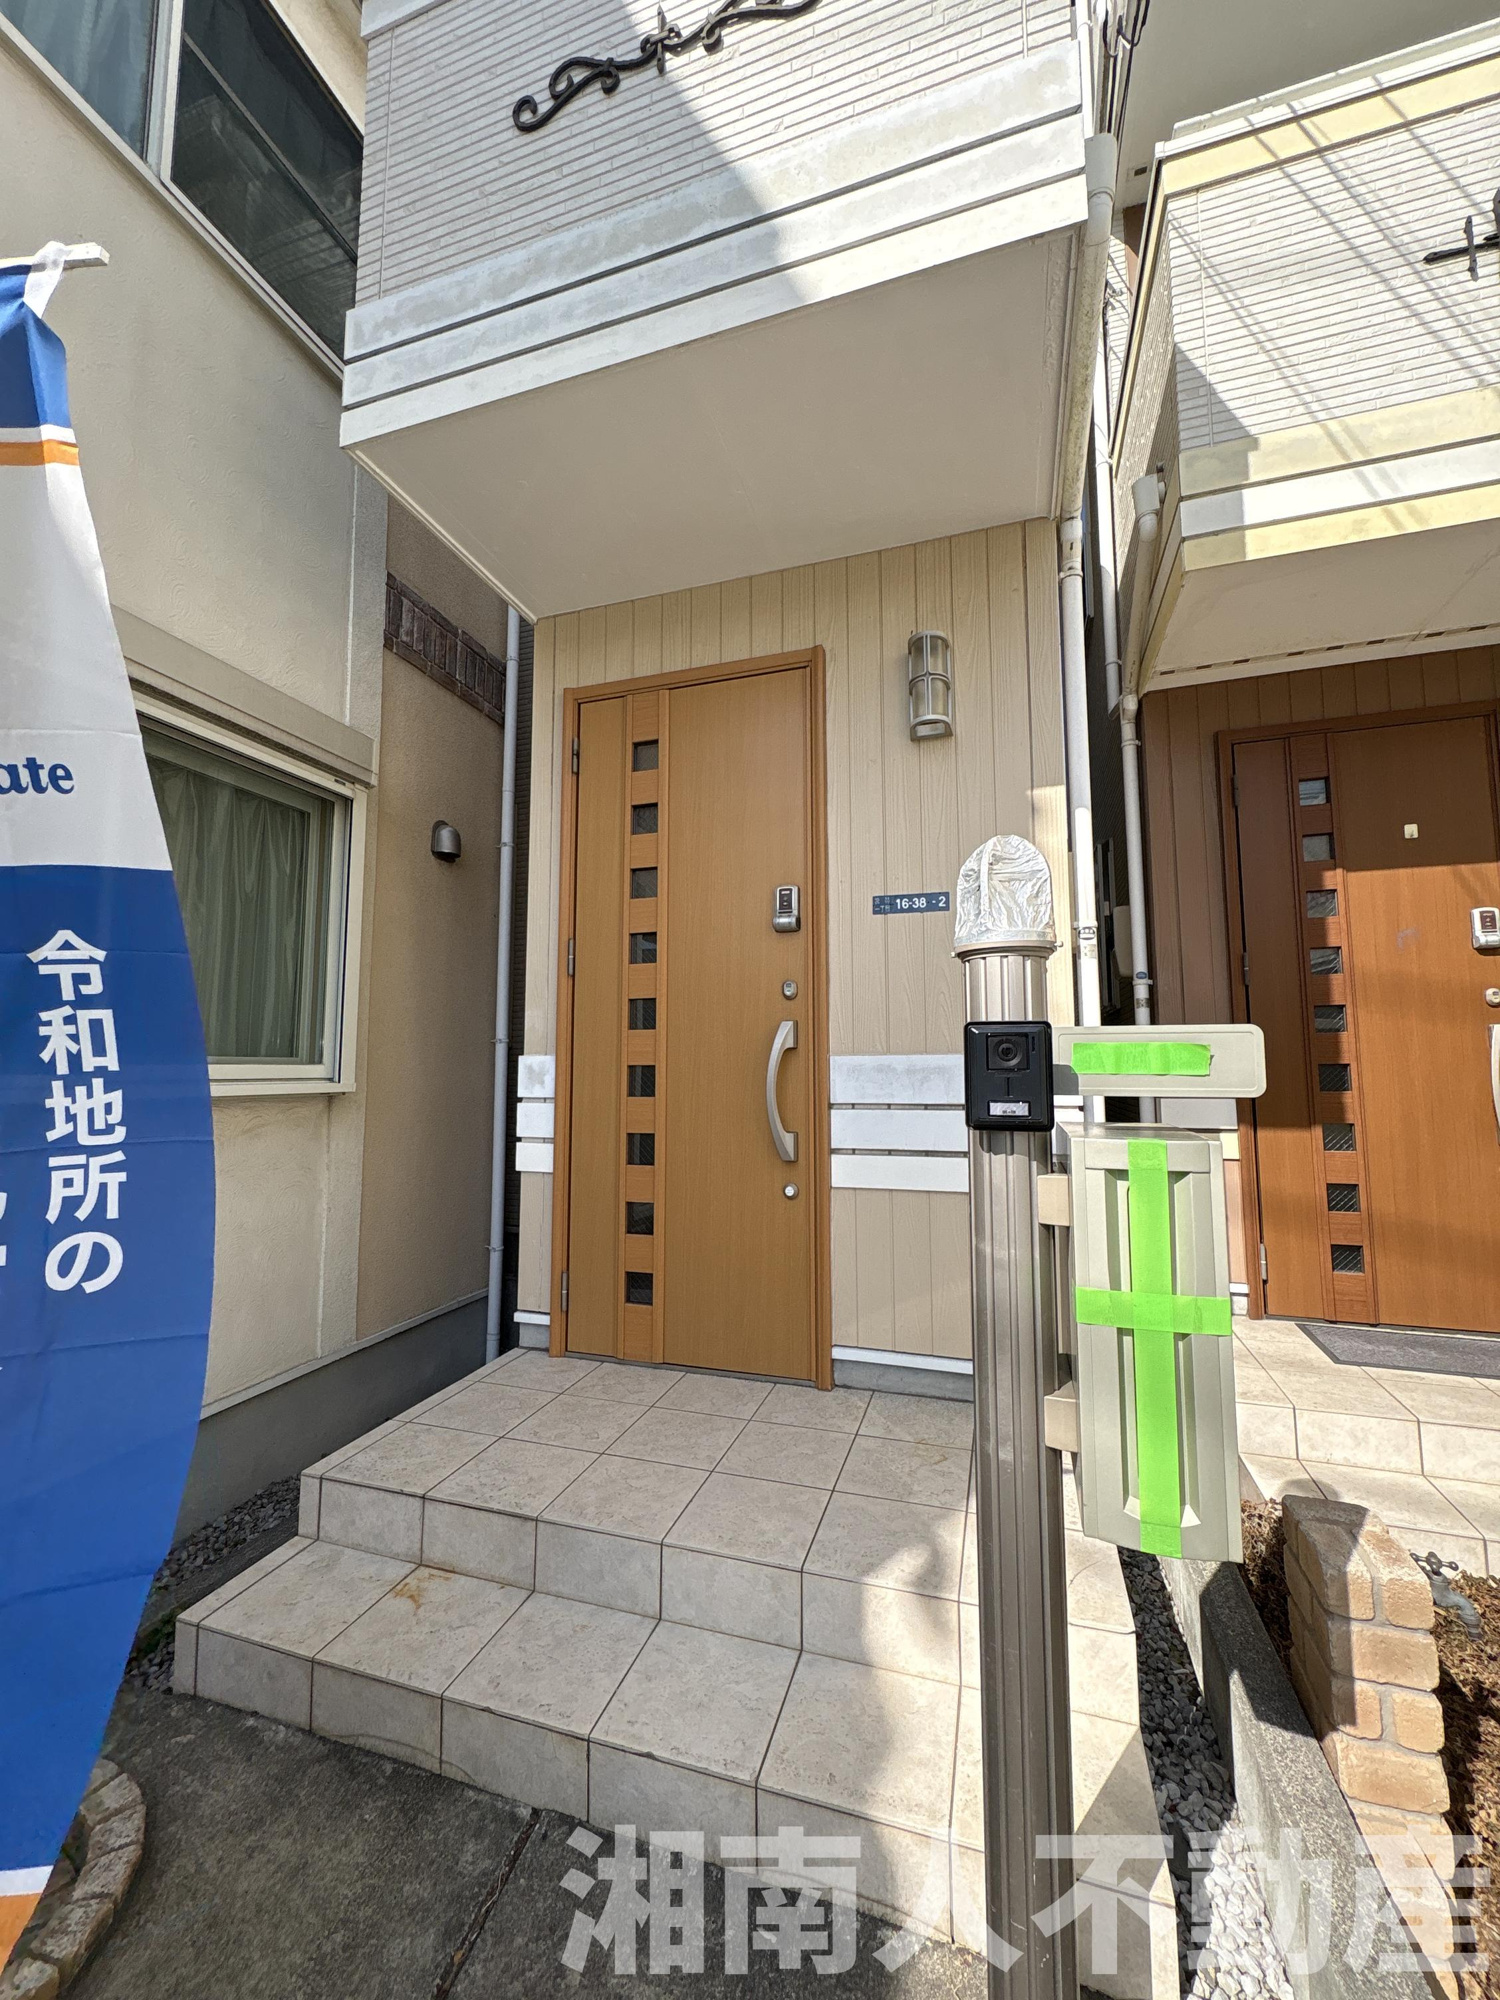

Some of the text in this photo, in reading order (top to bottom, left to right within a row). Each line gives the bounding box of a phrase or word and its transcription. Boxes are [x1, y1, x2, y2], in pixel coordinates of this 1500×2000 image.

[895, 897, 927, 909] 16-38
[27, 929, 127, 1294] 令和地所の
